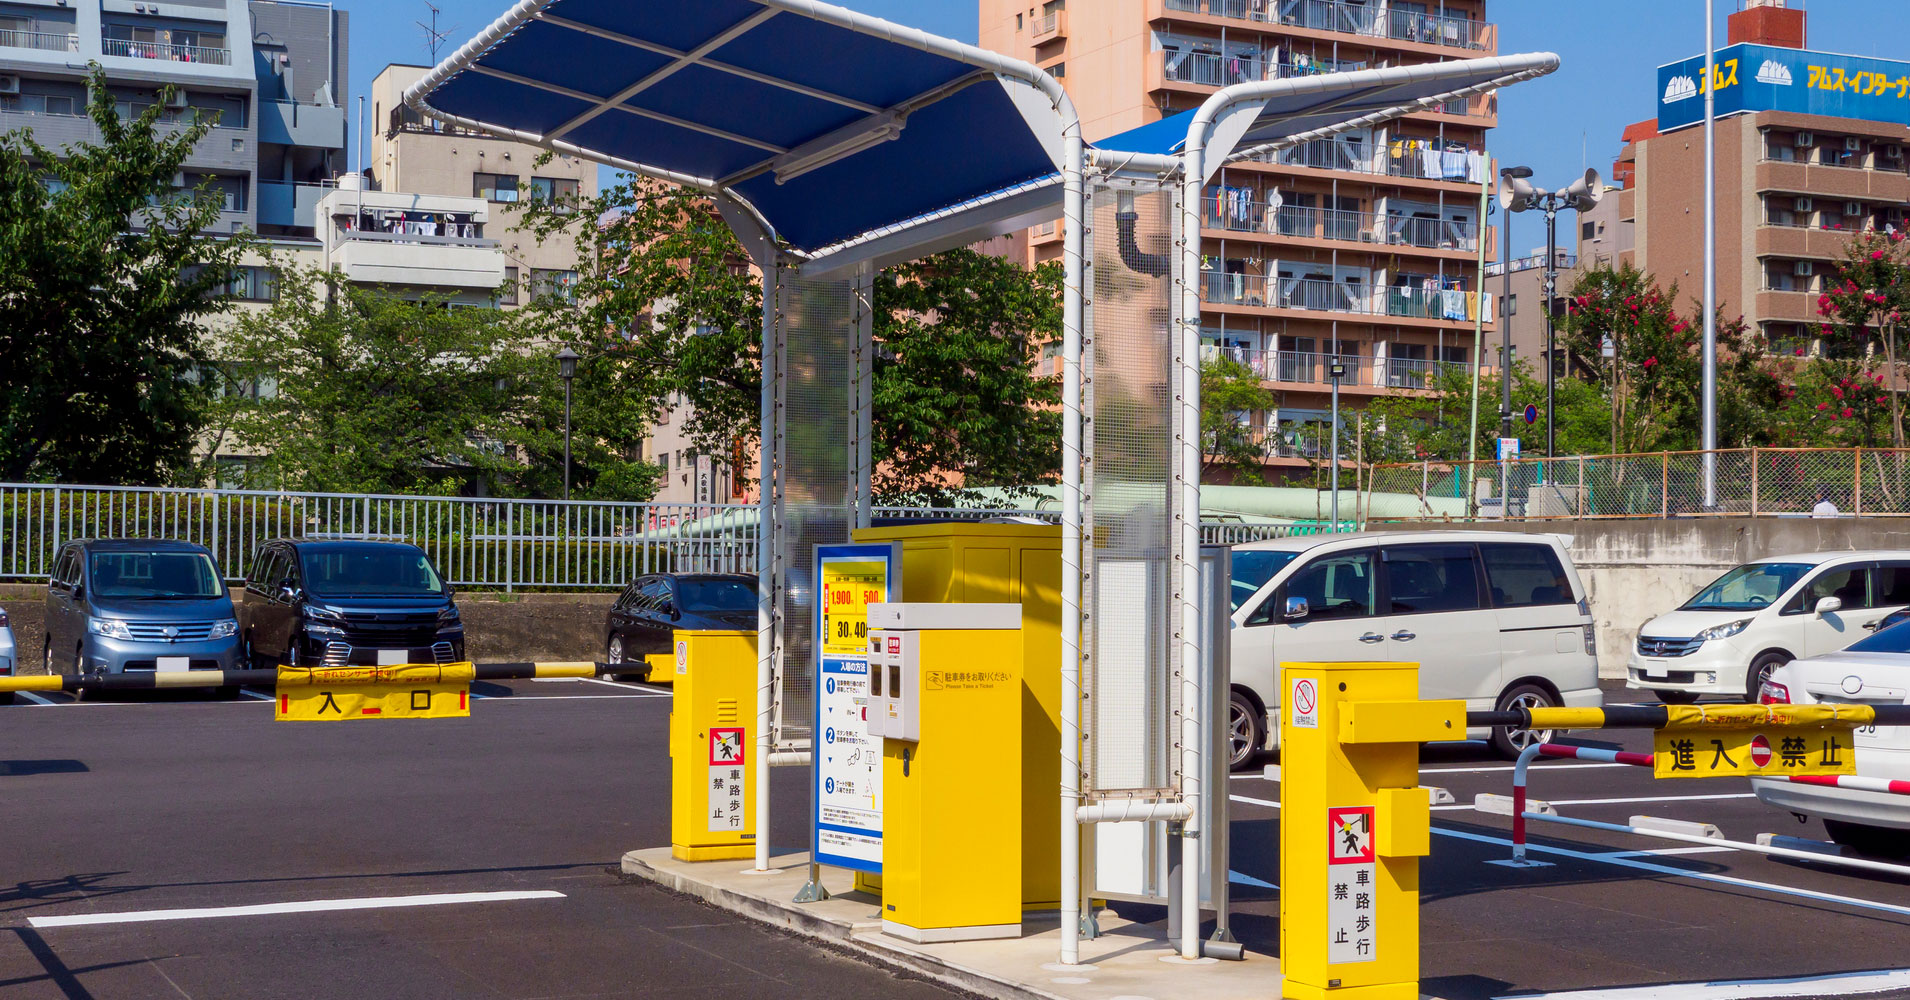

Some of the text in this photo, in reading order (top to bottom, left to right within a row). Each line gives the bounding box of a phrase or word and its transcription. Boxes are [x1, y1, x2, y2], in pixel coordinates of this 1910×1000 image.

[1807, 65, 1910, 99] アムス・インターナ
[945, 672, 1012, 682] 駐車券をお取りください
[712, 777, 724, 819] 禁止
[729, 769, 741, 827] 車路歩行
[1334, 883, 1350, 944] 禁止
[1355, 869, 1371, 956] 車路歩行
